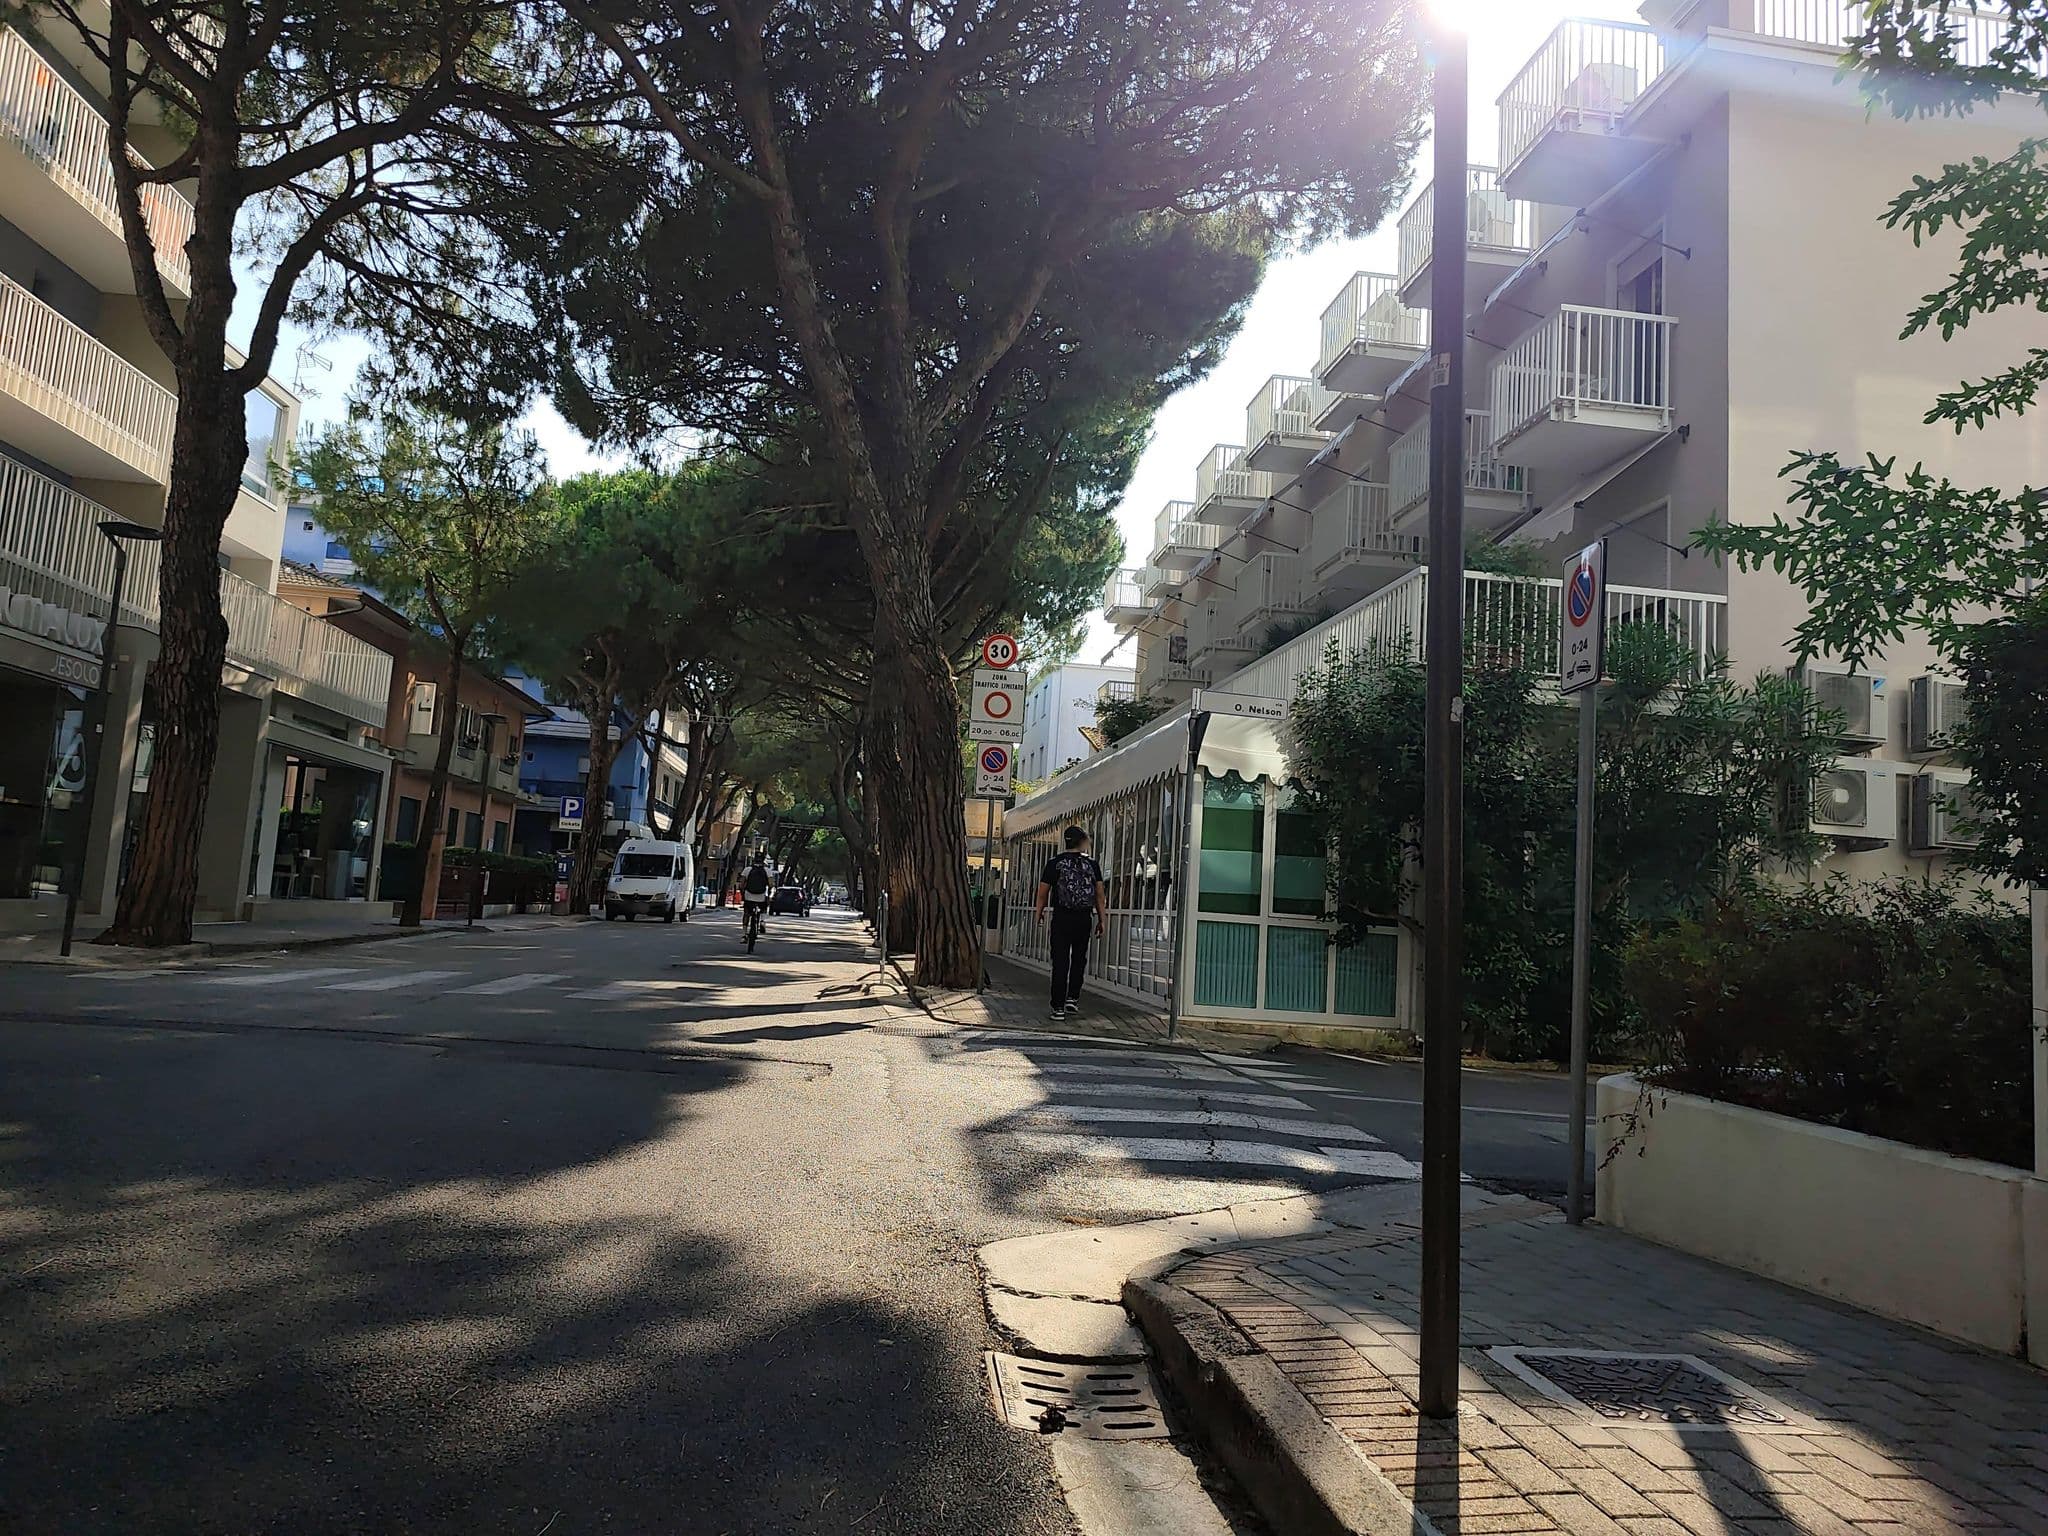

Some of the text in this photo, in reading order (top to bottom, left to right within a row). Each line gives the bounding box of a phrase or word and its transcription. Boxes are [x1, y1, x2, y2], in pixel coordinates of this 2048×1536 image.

[990, 644, 1010, 659] 30
[50, 654, 100, 684] JESOLO
[1001, 683, 1024, 691] LIMITATO
[1235, 704, 1281, 716] O. Nelson
[565, 799, 579, 816] P
